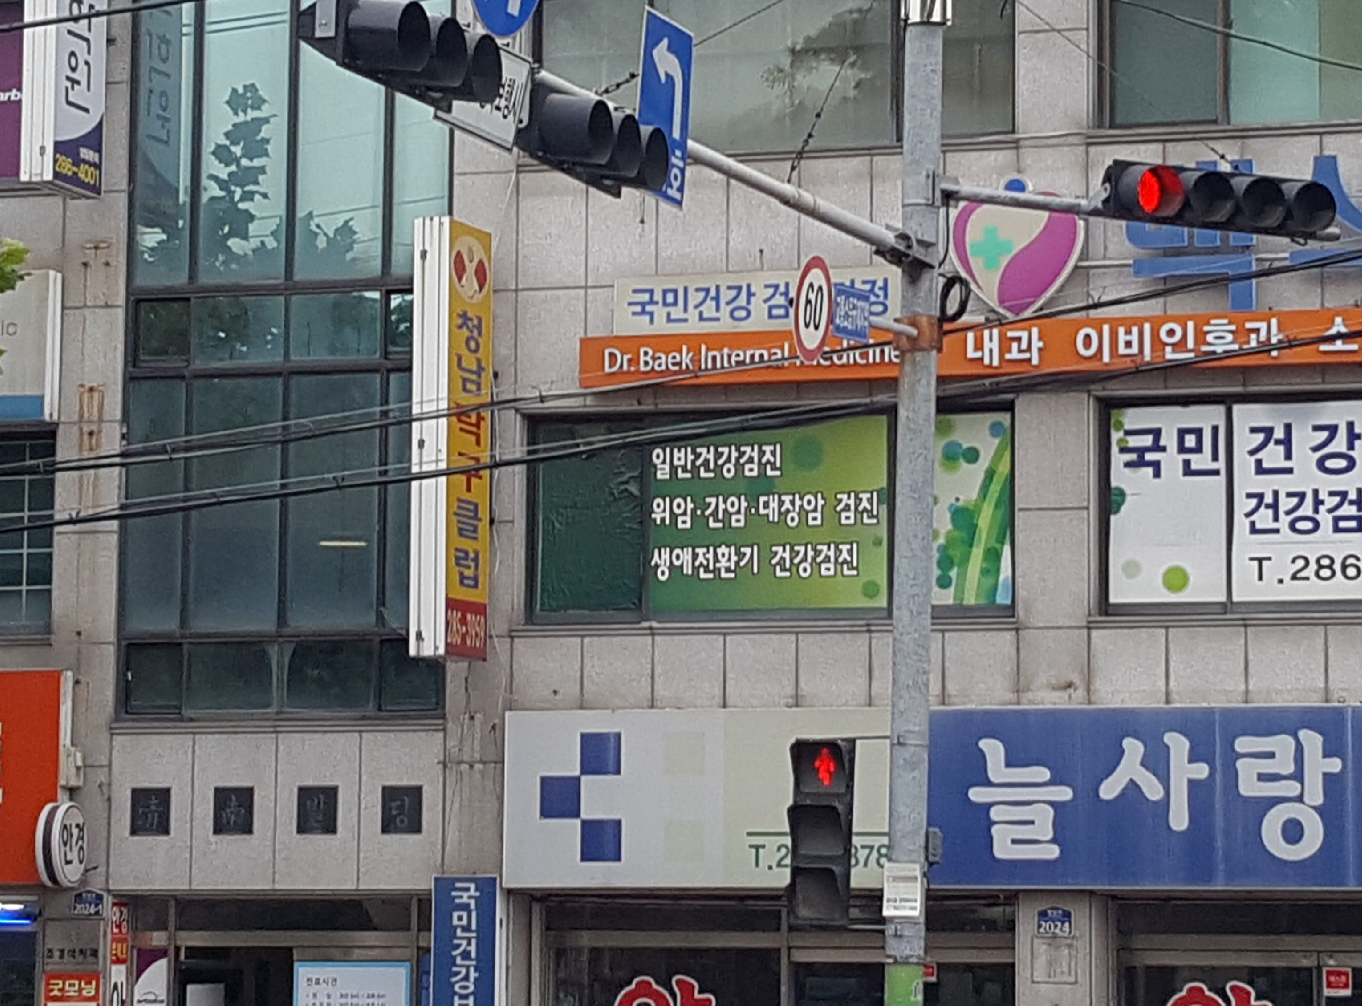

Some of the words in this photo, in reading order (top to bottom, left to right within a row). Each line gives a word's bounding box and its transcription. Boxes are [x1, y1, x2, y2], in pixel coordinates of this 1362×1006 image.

[803, 281, 824, 331] 60
[639, 344, 693, 372] Baek
[965, 326, 1043, 367] 내과
[1075, 318, 1283, 364] 이비인후과
[651, 442, 782, 482] 일반건강검진
[1118, 424, 1221, 478] 국민
[835, 492, 880, 527] 검진
[650, 544, 759, 582] 생애전환기
[770, 541, 859, 579] 건강검진
[447, 607, 486, 652] 285-3959
[61, 821, 86, 867] 안경
[1039, 921, 1070, 934] 2024
[49, 979, 97, 997] 굿모닝
